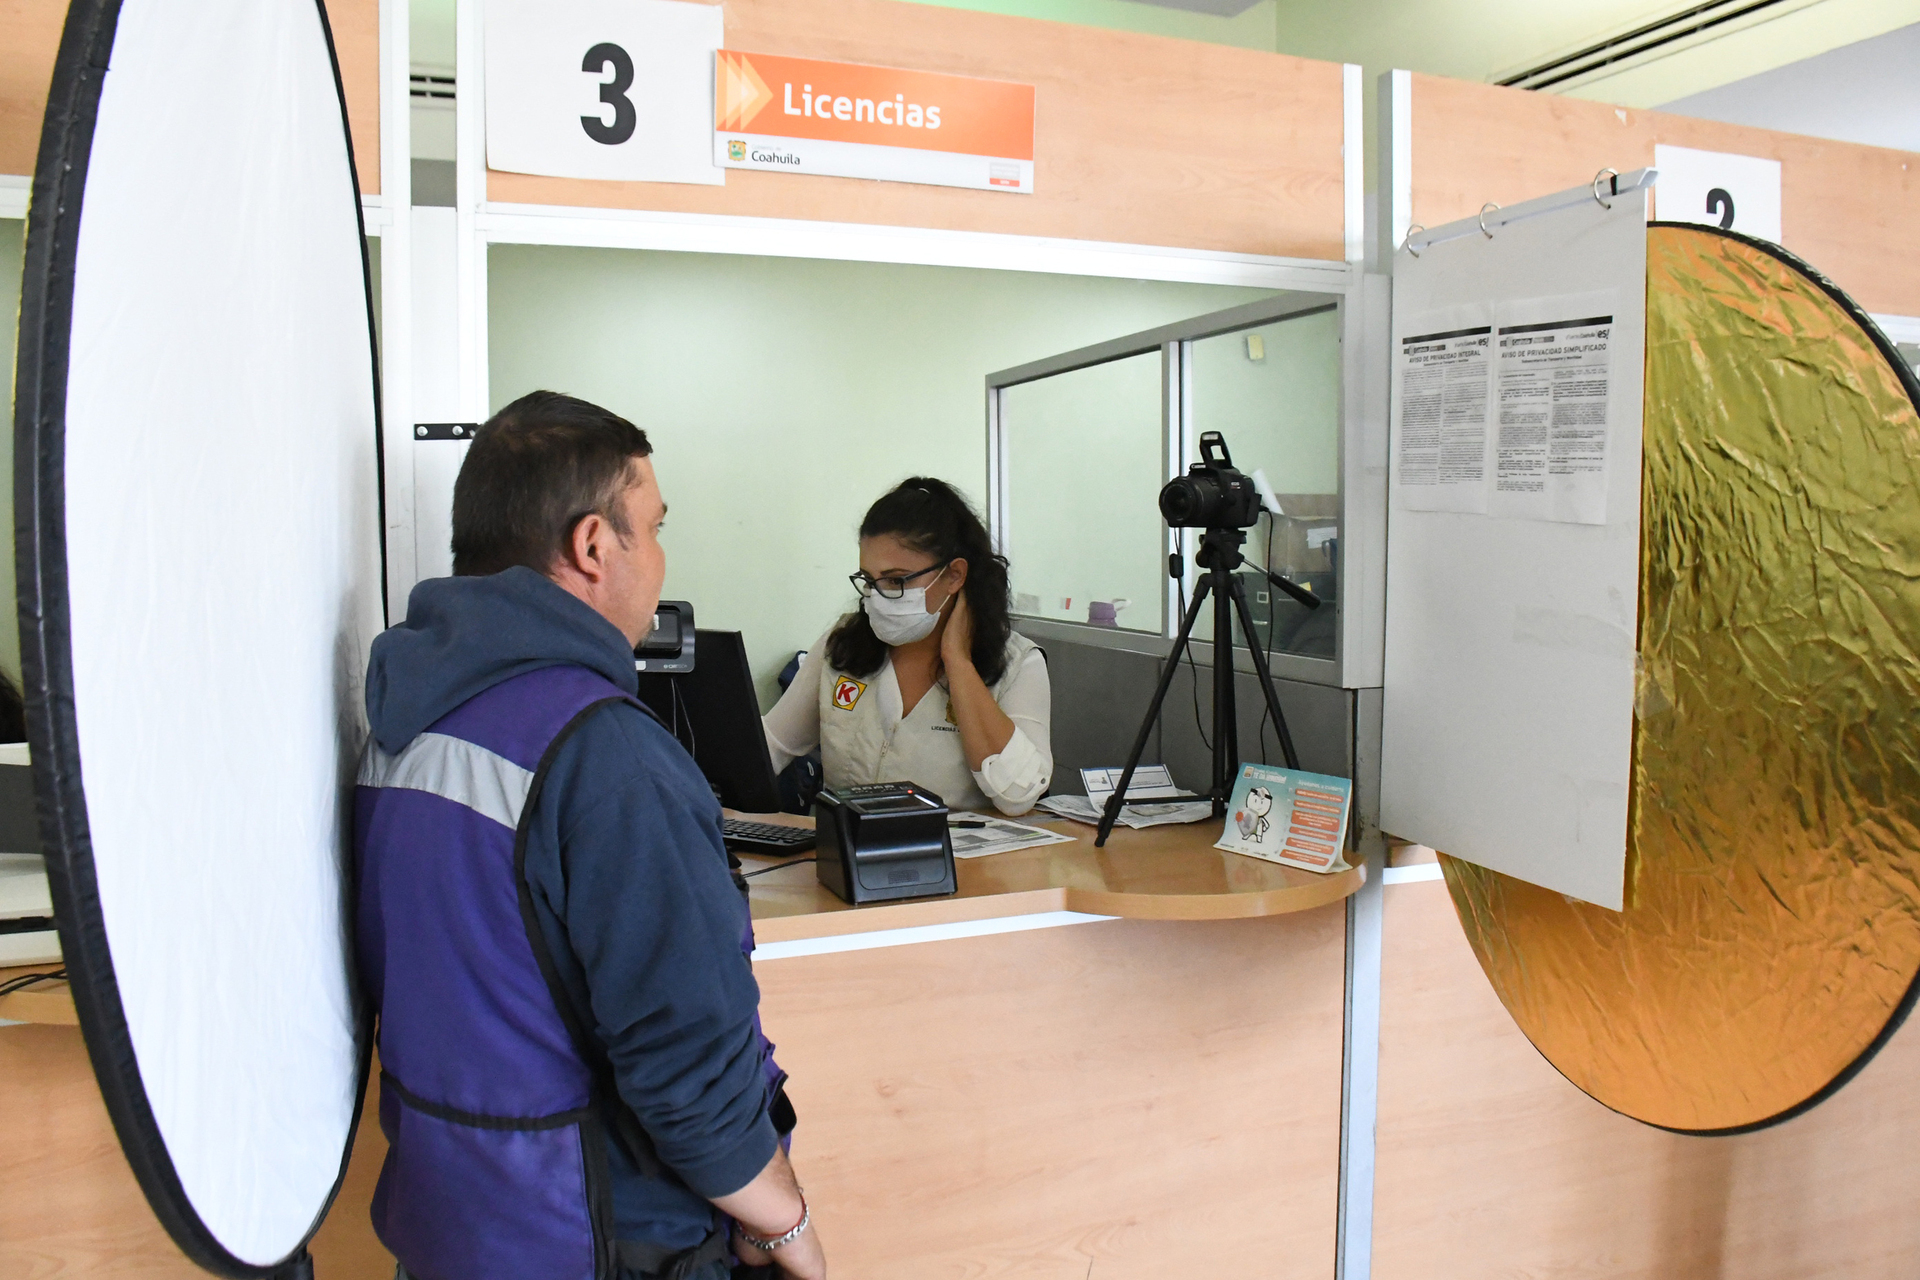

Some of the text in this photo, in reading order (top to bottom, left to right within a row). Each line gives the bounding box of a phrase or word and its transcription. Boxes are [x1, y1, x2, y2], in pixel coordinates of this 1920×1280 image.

[580, 42, 636, 145] 3
[784, 83, 941, 129] Licencias
[751, 150, 801, 165] Coahuila
[1409, 355, 1422, 363] AVISO
[1430, 352, 1457, 361] PRIVACIDAD
[1458, 349, 1481, 358] INTEGRAL
[1501, 351, 1516, 359] AVISO
[1527, 347, 1562, 357] PRIVACIDAD
[1563, 343, 1607, 354] SIMPLIFICADO
[837, 683, 857, 703] K
